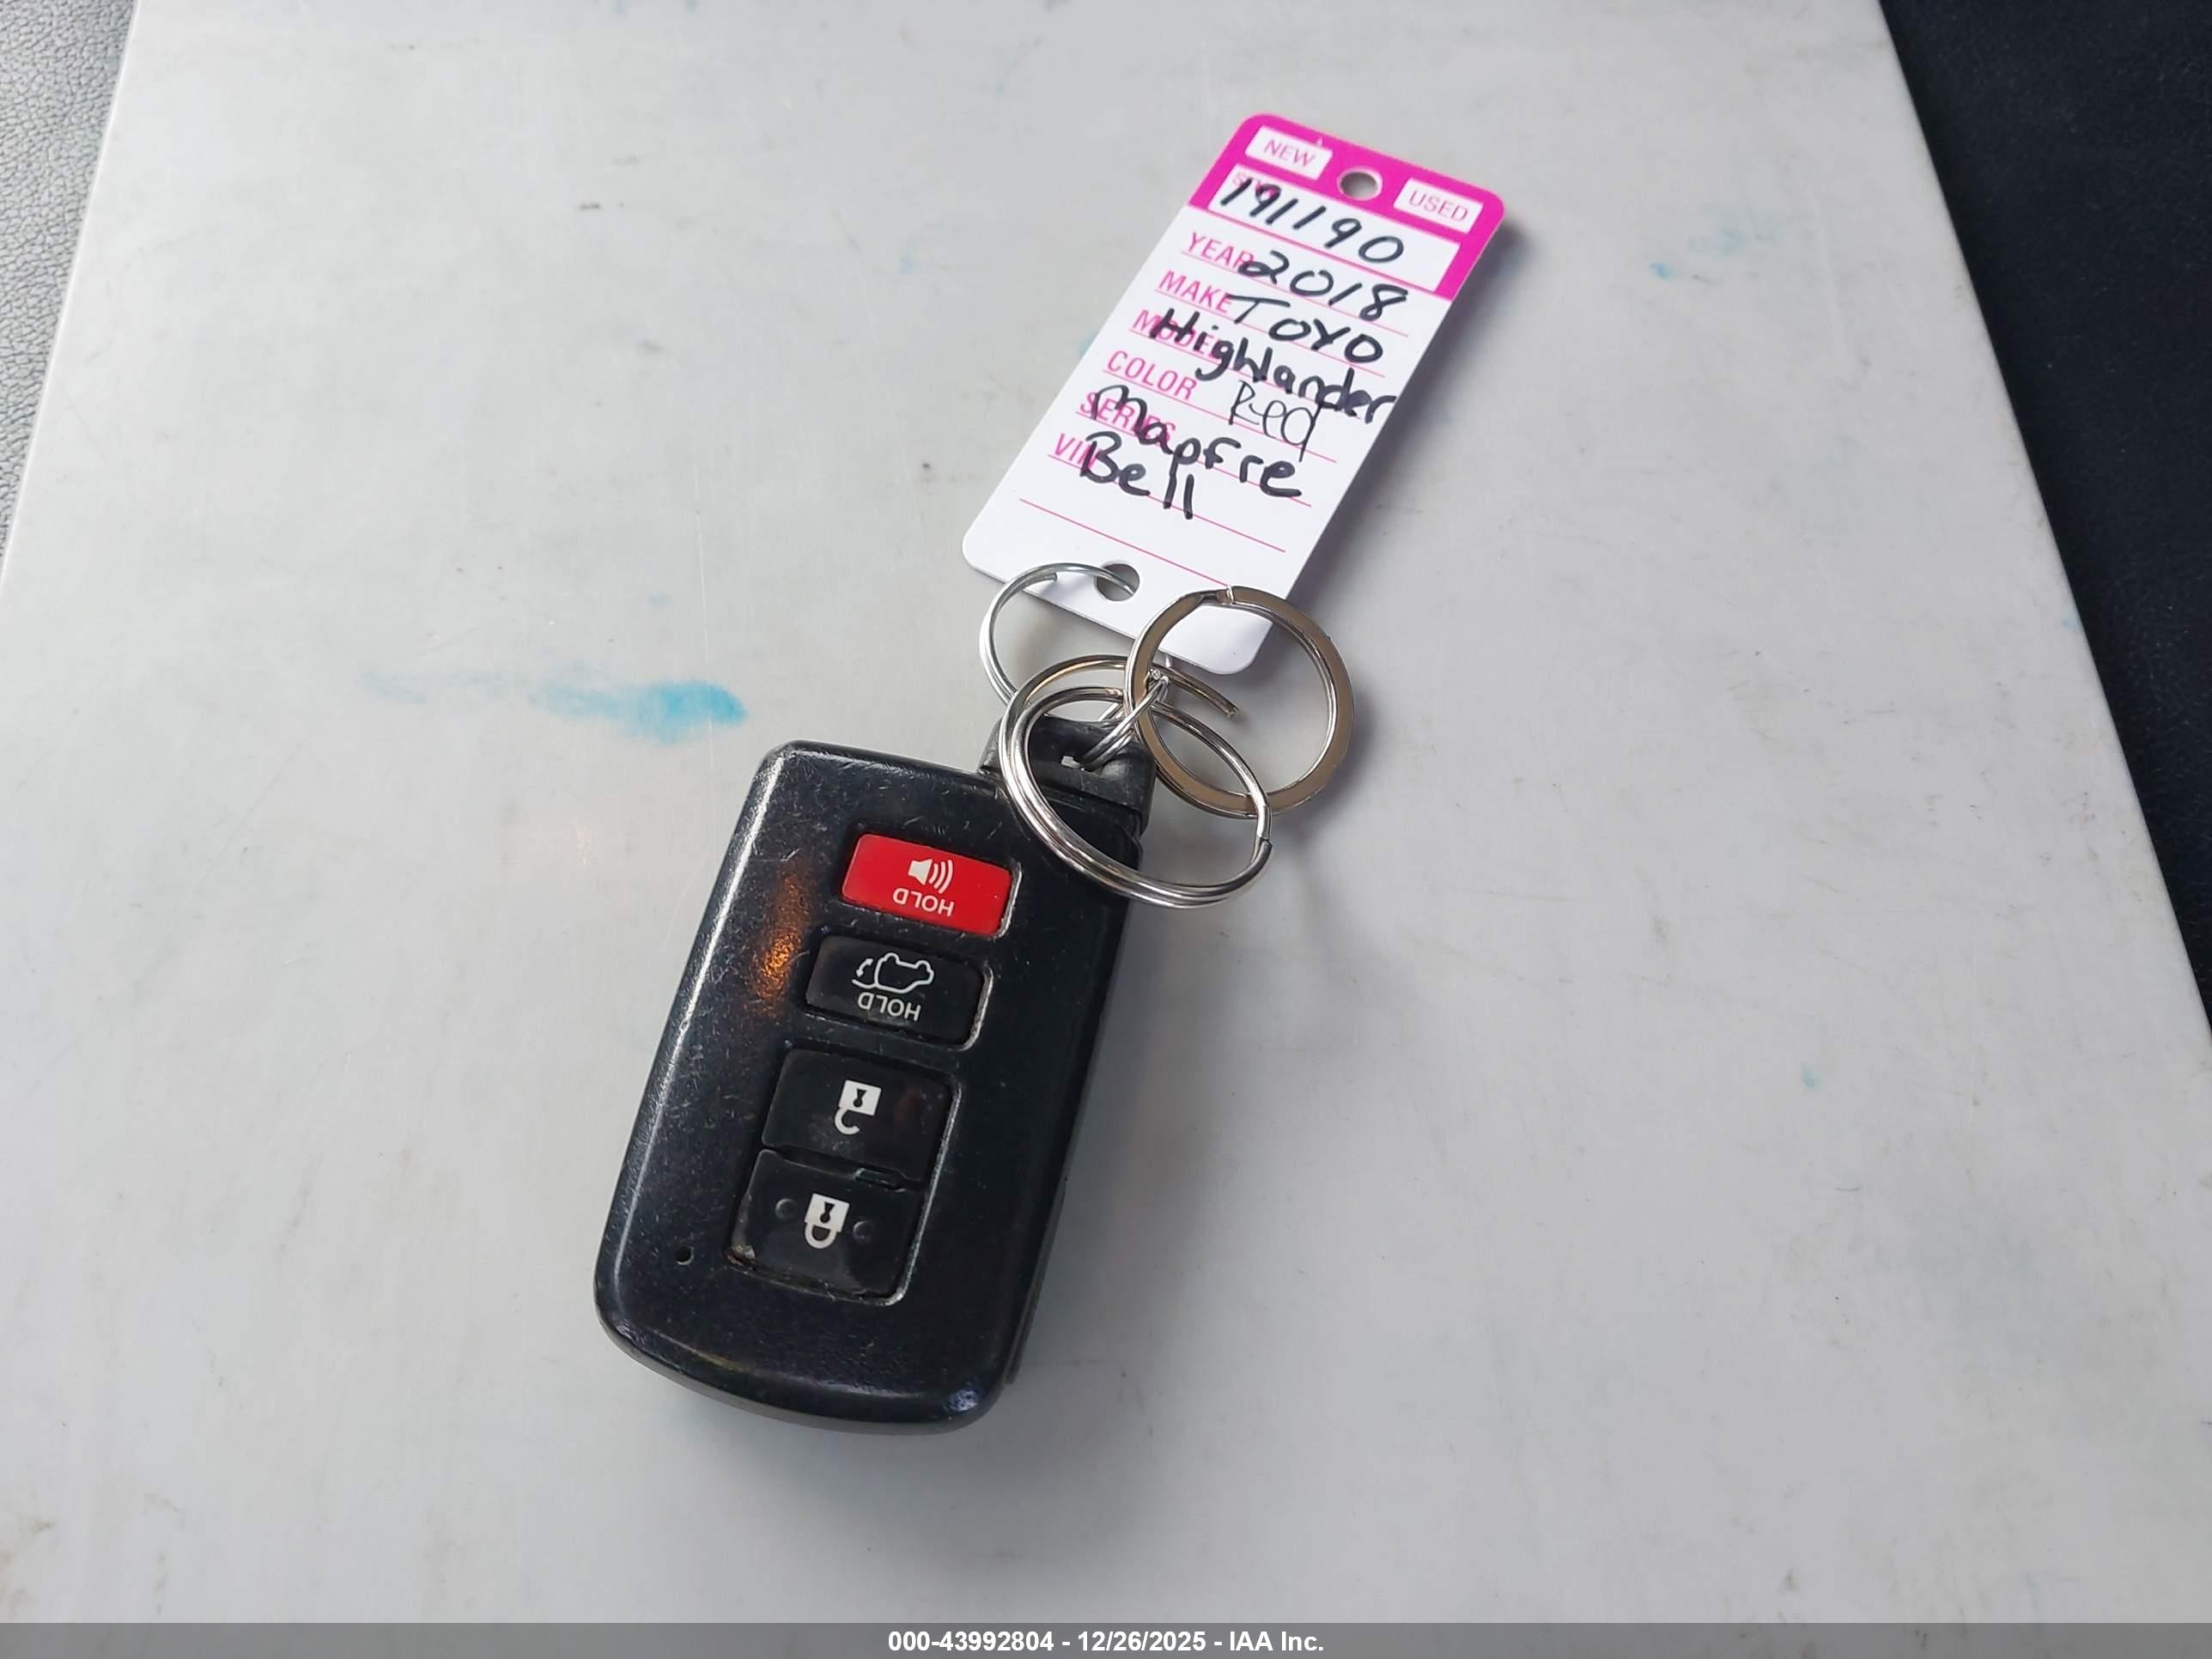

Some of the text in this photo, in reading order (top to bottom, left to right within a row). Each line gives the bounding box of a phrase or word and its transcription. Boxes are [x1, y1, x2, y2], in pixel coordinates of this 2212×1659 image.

[1262, 137, 1316, 168] NEW
[1219, 177, 1405, 264] 191190
[1408, 188, 1471, 223] USED
[1188, 231, 1255, 272] YEAR
[1158, 270, 1232, 314] MAKE
[1237, 249, 1410, 322] 2018
[1132, 307, 1224, 360] MODE
[1106, 349, 1198, 401] COLOR
[1147, 307, 1398, 424] Highlander
[1079, 430, 1195, 520] Bell
[892, 887, 955, 917] HOLD
[858, 991, 921, 1022] HOLD
